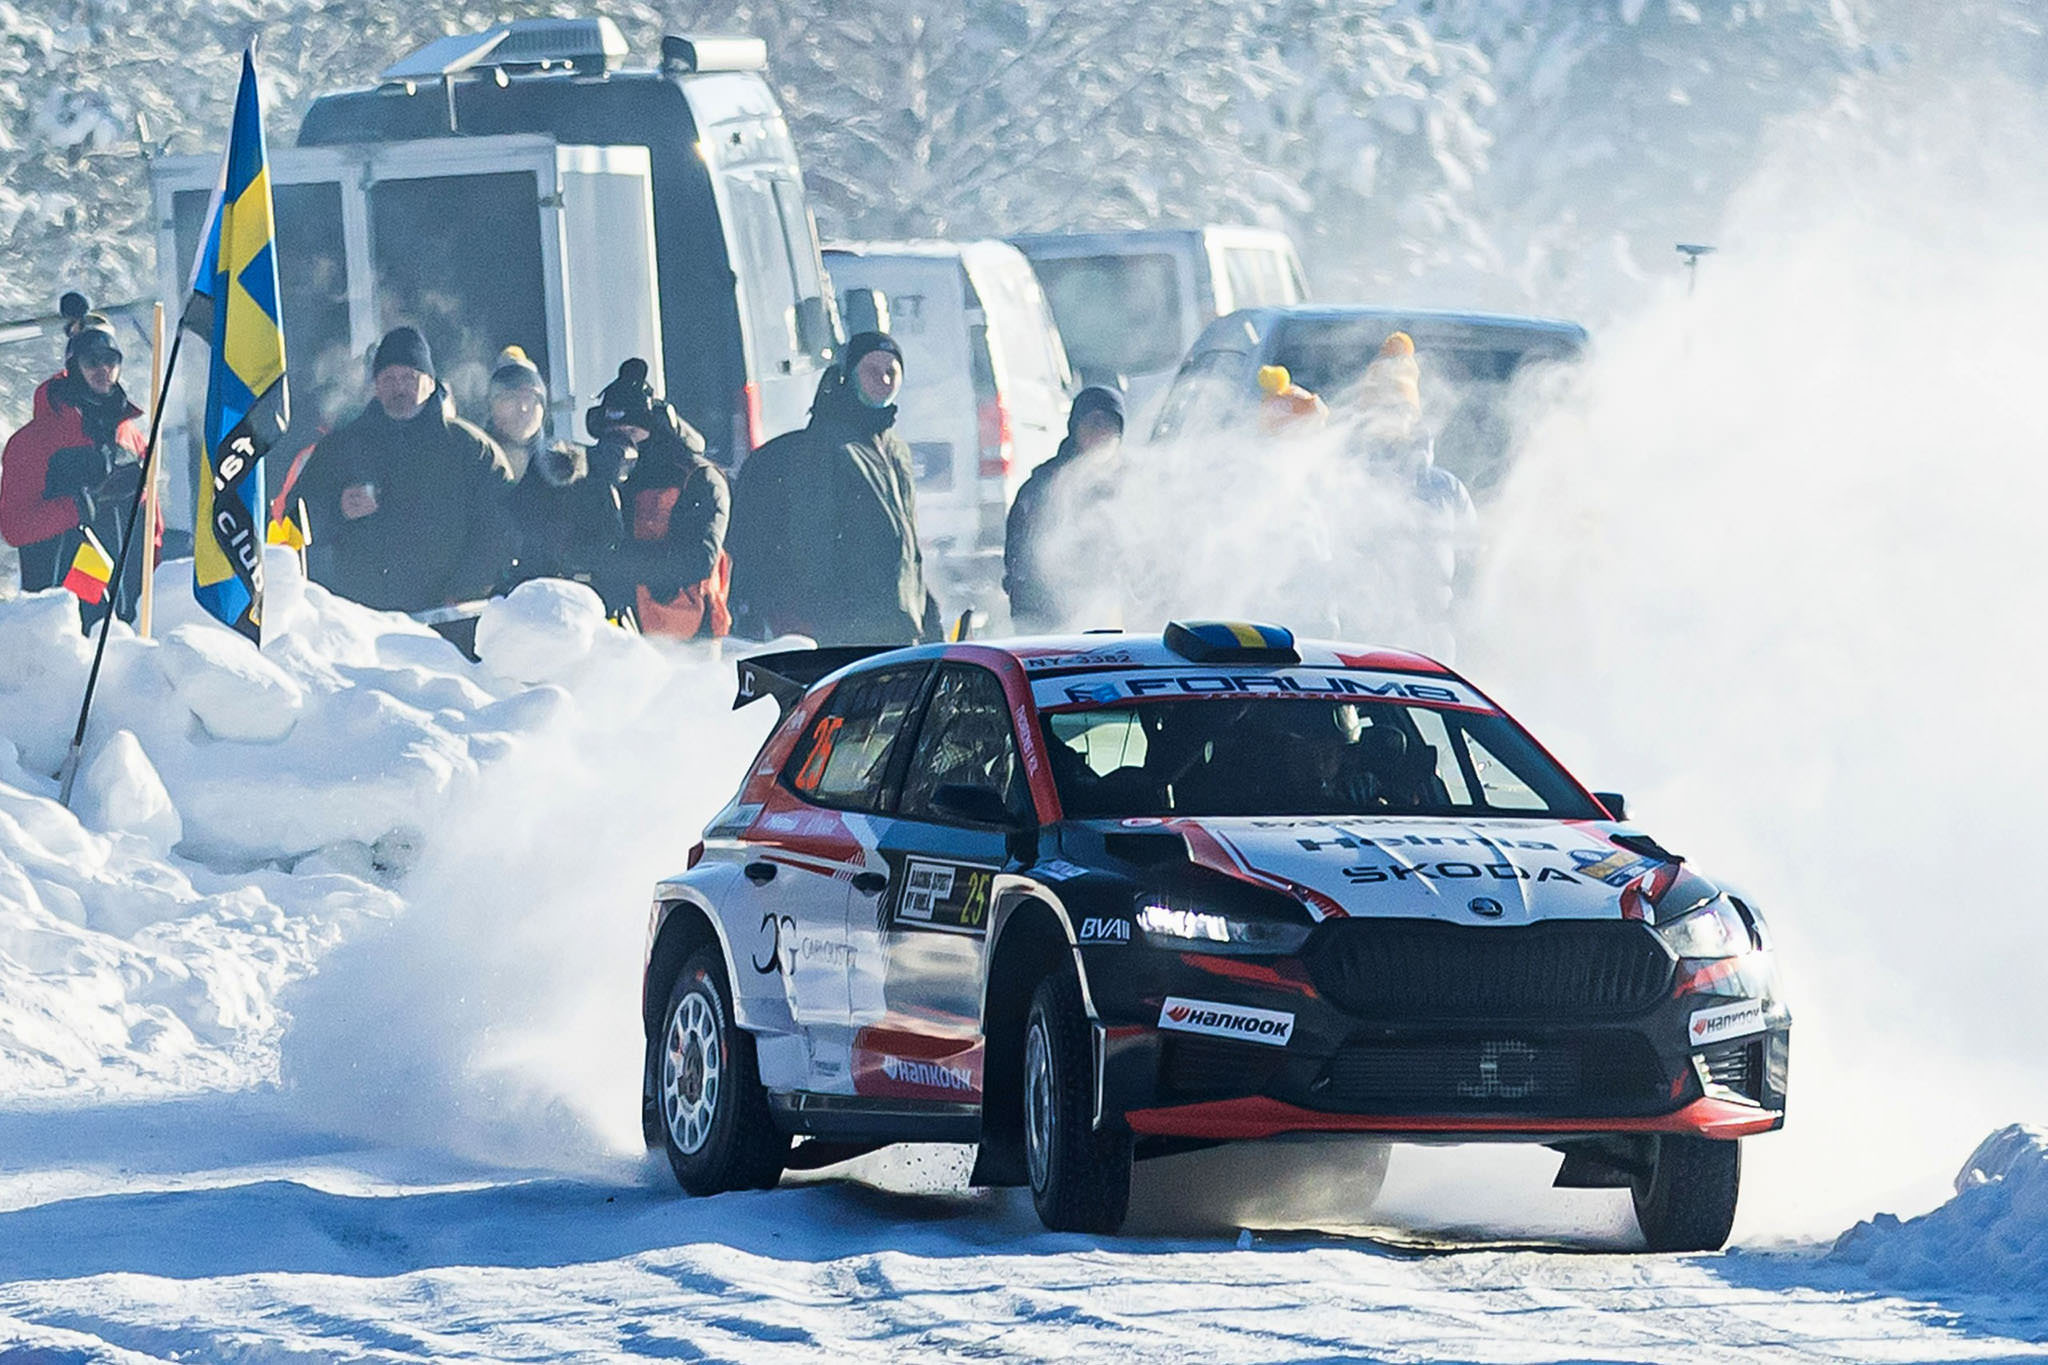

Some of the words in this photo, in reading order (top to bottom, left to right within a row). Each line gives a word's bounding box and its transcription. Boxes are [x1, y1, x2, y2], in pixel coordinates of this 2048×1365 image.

[1125, 677, 1461, 703] FORUM8
[795, 717, 843, 789] 25
[961, 871, 990, 925] 25
